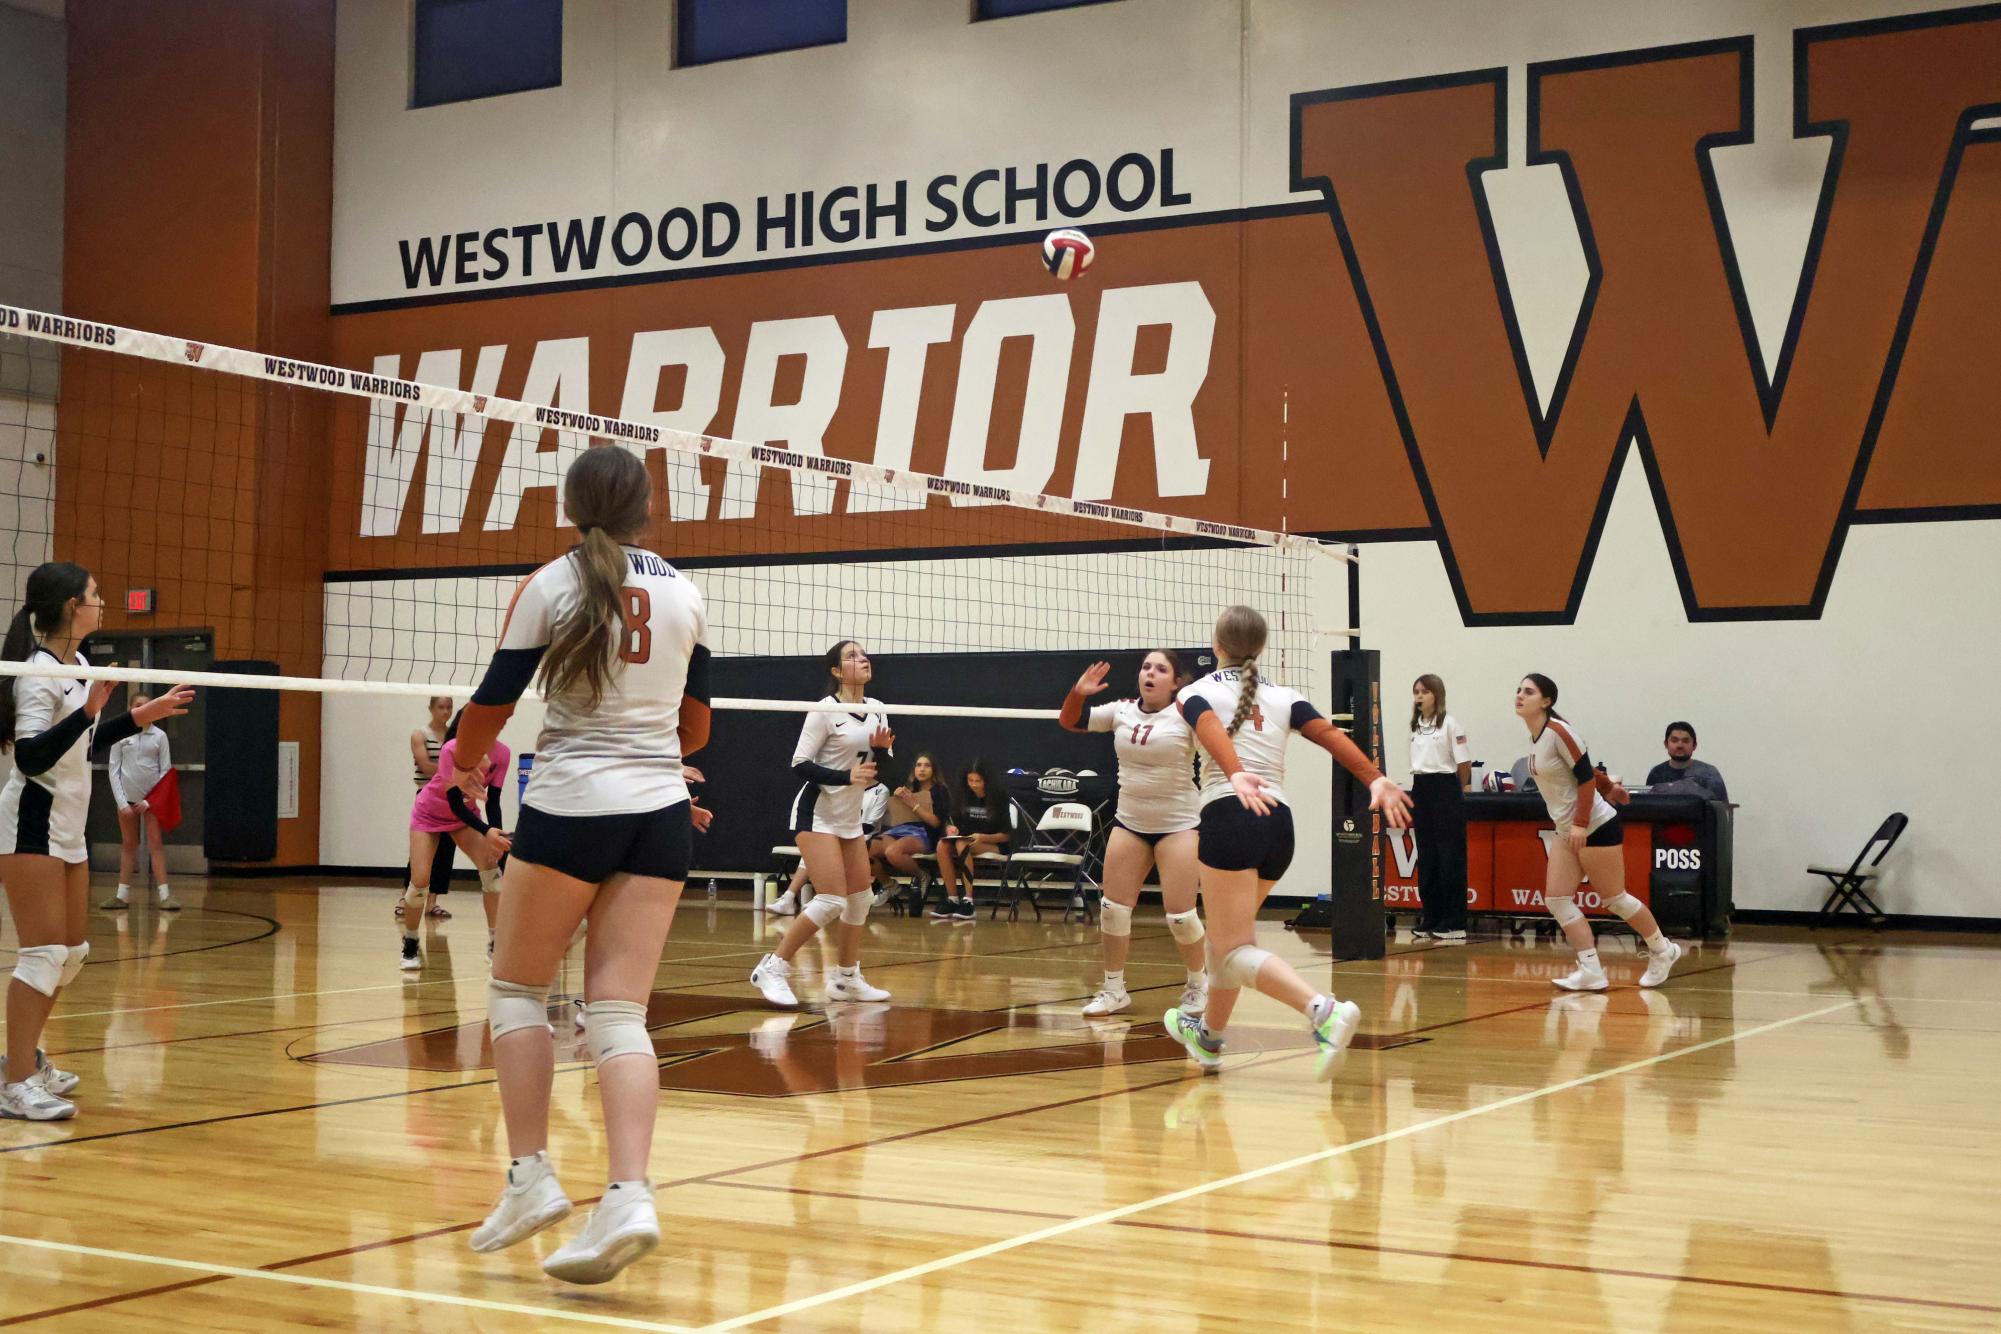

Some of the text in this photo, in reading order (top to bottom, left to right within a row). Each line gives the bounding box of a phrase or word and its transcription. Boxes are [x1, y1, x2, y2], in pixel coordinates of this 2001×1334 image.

[399, 148, 1191, 289] WESTWOOD HIGH SCHOOL
[27, 313, 116, 346] WARRIORS
[265, 357, 420, 401] WESTWOOD WARRIORS
[359, 281, 1217, 538] WARRIOR
[536, 407, 659, 442] WESTWOOD WARRIORS
[751, 446, 852, 476] WESTWOOD WARRIORS
[927, 477, 1011, 502] WESTWOOD WARRIORS
[1073, 501, 1143, 522] WESTWOOD WARRIORS
[620, 586, 651, 664] 8
[1130, 723, 1154, 746] 17
[1038, 778, 1077, 792] TACHIKARA
[1655, 848, 1701, 870] POSS
